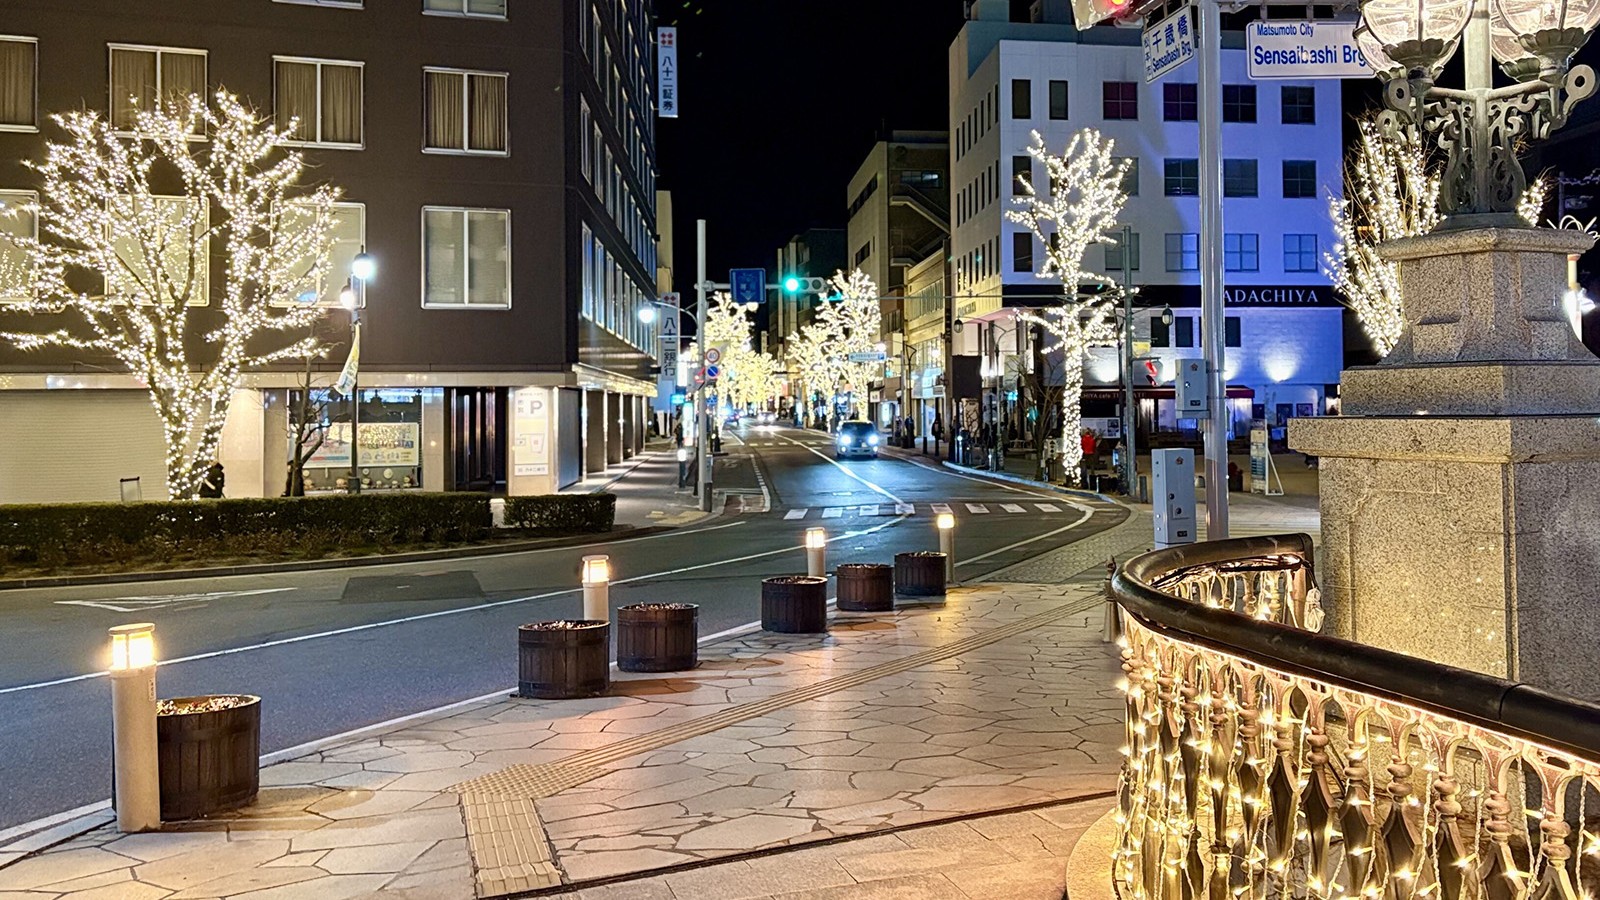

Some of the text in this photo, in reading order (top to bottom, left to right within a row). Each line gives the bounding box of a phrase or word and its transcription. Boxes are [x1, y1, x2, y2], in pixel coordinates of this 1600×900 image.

[1152, 14, 1188, 53] 千歳橋
[1257, 23, 1314, 38] Matsumoto City
[1254, 45, 1337, 66] Sensaibashi
[662, 56, 674, 111] 八十二証券
[664, 317, 676, 376] 八十二銀行
[530, 400, 543, 414] P
